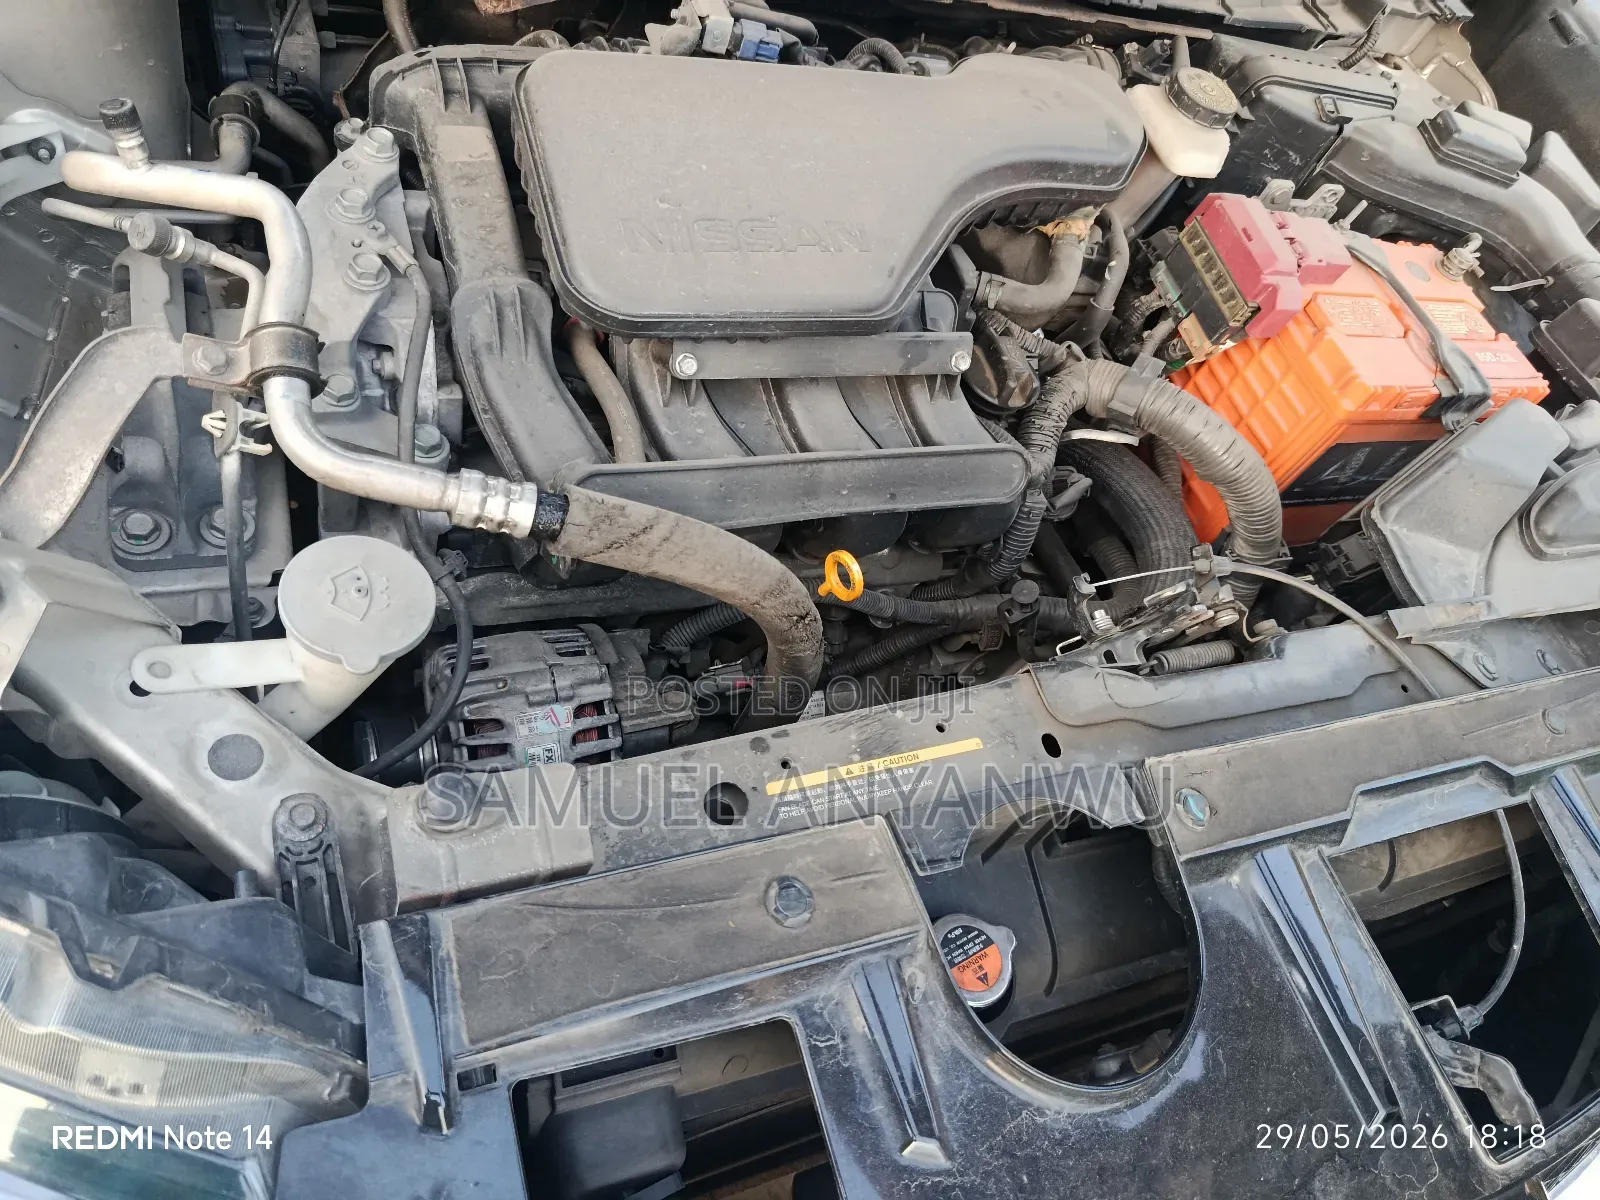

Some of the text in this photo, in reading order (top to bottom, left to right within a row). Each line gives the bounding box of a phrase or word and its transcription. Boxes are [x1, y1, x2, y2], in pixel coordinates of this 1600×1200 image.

[619, 218, 870, 253] NISSAN
[882, 753, 920, 767] CAUTION
[825, 793, 843, 802] START
[789, 808, 806, 817] HELP
[958, 952, 988, 973] WARNING
